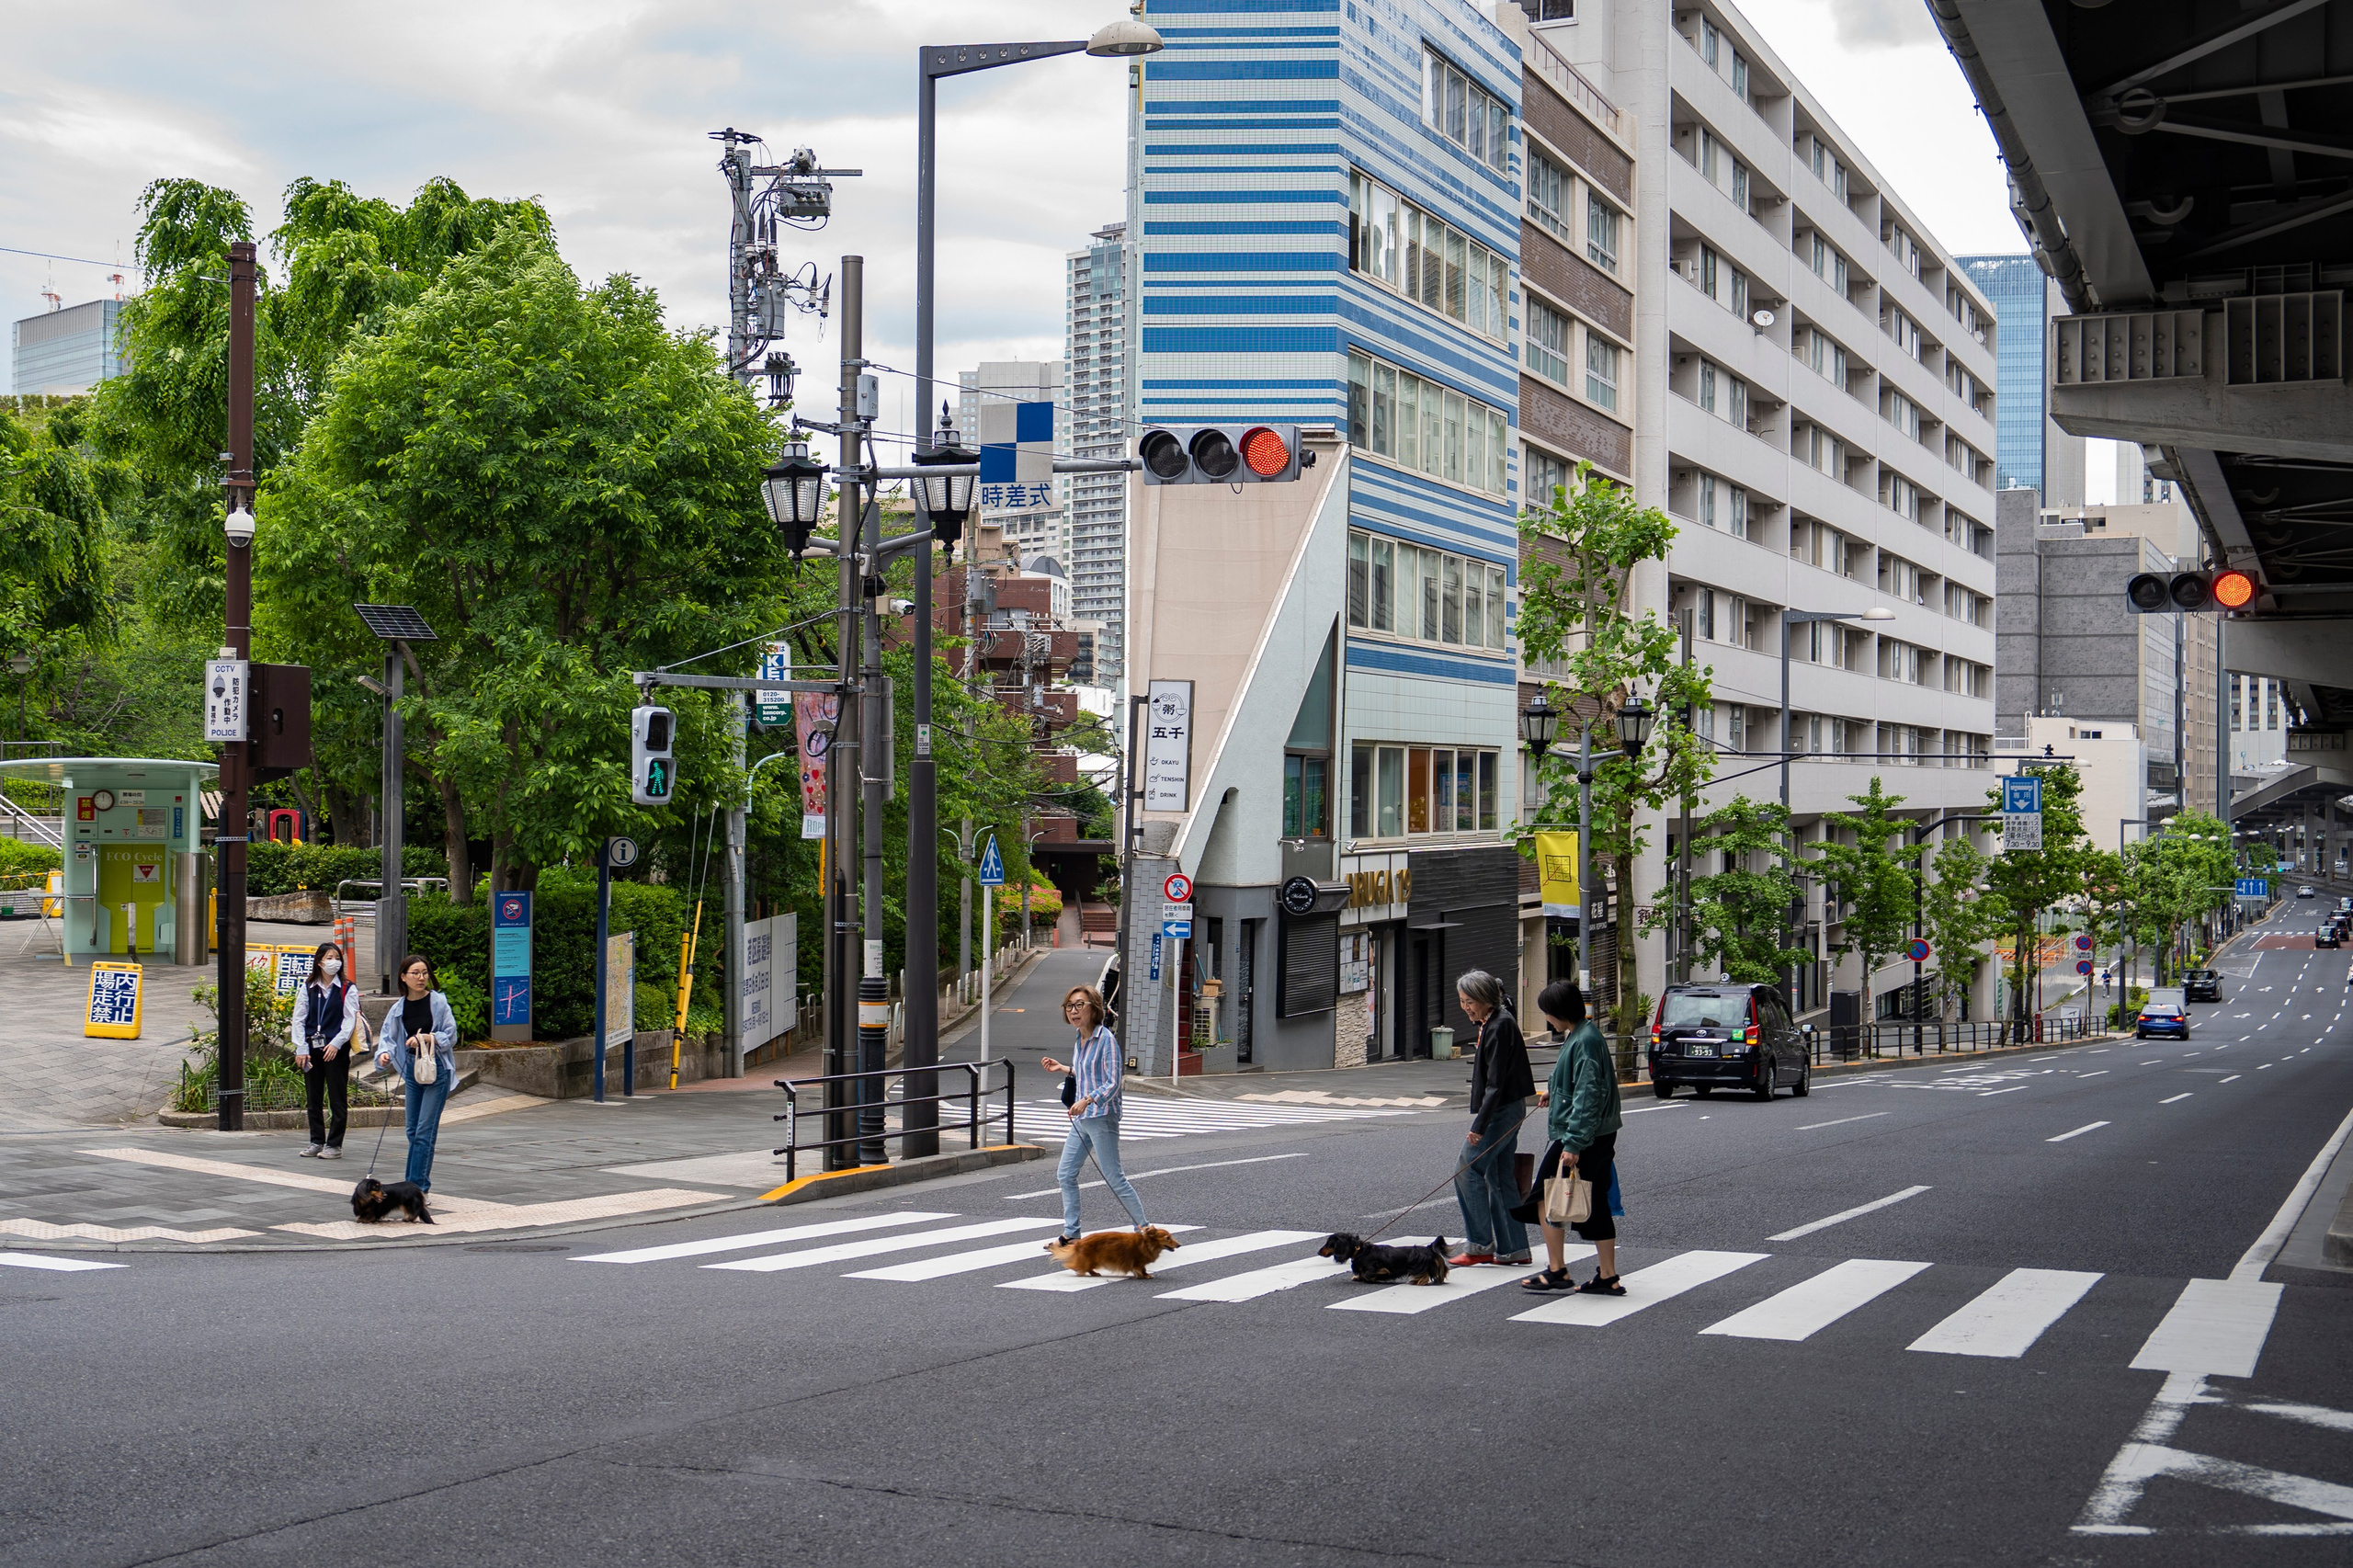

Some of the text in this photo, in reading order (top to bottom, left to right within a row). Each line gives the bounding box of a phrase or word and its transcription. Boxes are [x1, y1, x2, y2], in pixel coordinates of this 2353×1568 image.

[982, 483, 1051, 507] 時差式
[767, 655, 780, 680] KE
[223, 698, 232, 725] 作動中
[1162, 704, 1176, 715] 粥
[1152, 726, 1185, 739] 五千
[106, 851, 164, 863] ECO Cycle
[1591, 902, 1604, 919] 花屋
[280, 954, 314, 975] 自転車
[96, 971, 137, 991] 場内
[93, 989, 135, 1007] 走行
[92, 1006, 132, 1025] 禁止
